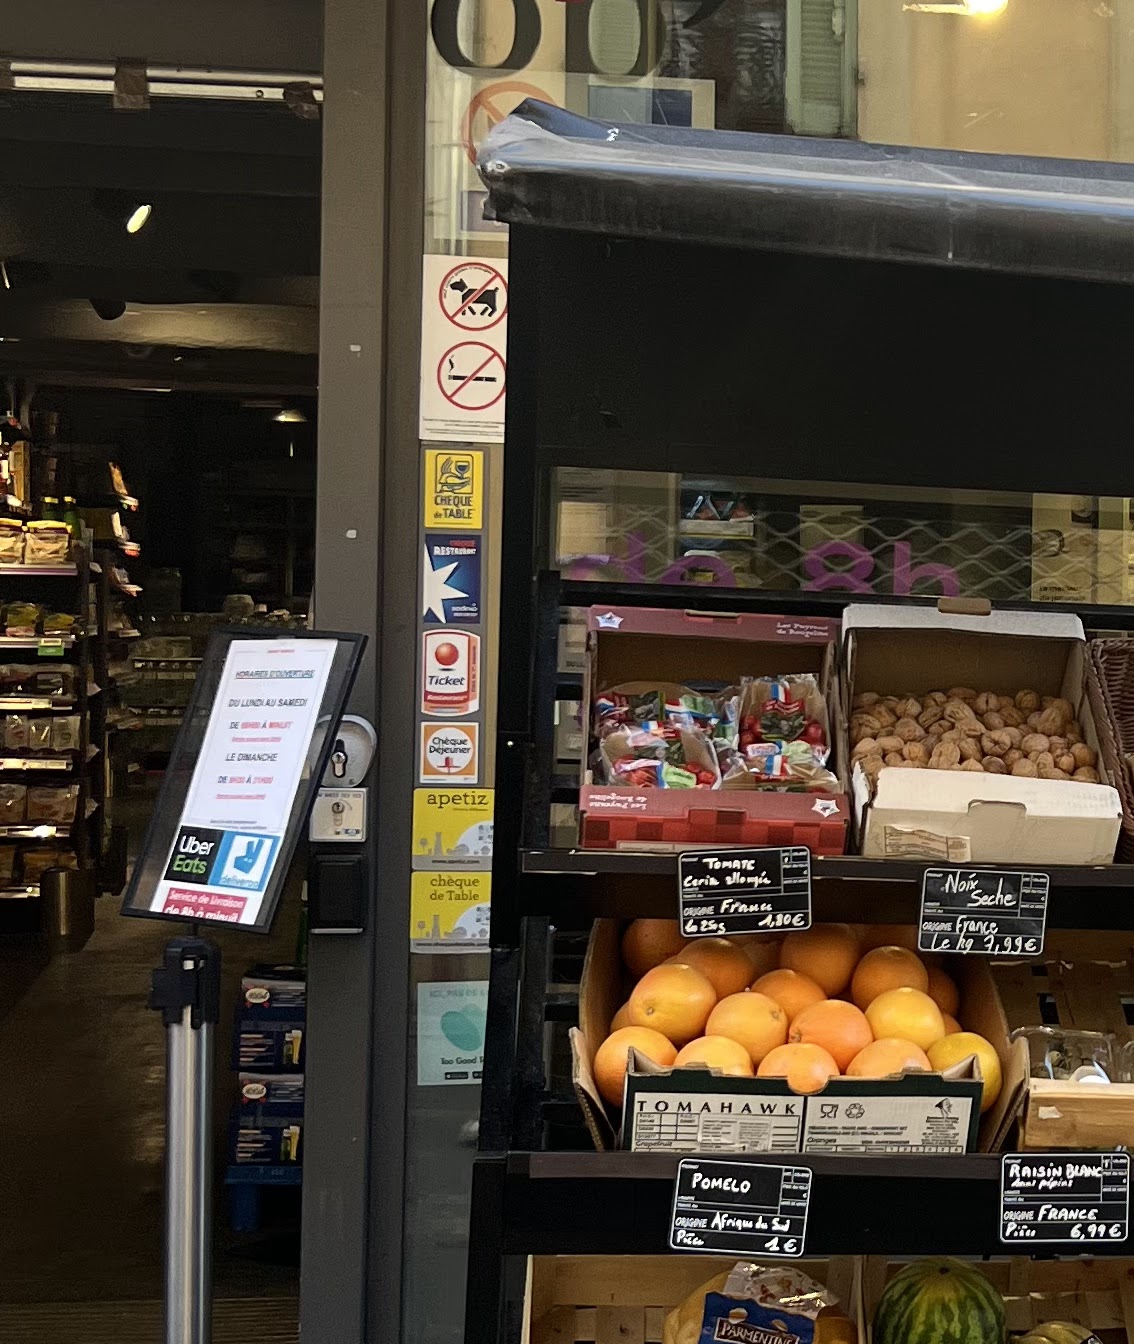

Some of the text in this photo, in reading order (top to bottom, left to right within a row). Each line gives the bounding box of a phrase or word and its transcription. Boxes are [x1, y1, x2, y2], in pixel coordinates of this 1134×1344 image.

[443, 508, 473, 519] TABLE
[428, 675, 465, 686] Ticket
[278, 698, 308, 707] SAMEDI
[226, 753, 236, 761] LE
[427, 791, 489, 809] apetiz
[180, 835, 215, 855] Uber
[172, 855, 208, 874] Eats
[702, 858, 756, 870] TOMATE
[430, 874, 480, 890] chèque
[944, 871, 979, 894] Noix
[169, 891, 197, 902] Service
[198, 894, 208, 904] de
[430, 890, 479, 901] de Table
[720, 899, 772, 913] France
[956, 915, 999, 935] France
[931, 932, 951, 951] Le
[637, 1100, 796, 1115] TOMAHAWK
[1009, 1163, 1062, 1178] RAISIN
[1065, 1164, 1102, 1178] BLANC
[691, 1172, 751, 1193] POMELO
[1038, 1205, 1098, 1222] FRANCE
[711, 1212, 754, 1230] Afrique
[755, 1216, 768, 1230] du
[771, 1218, 790, 1232] Sud
